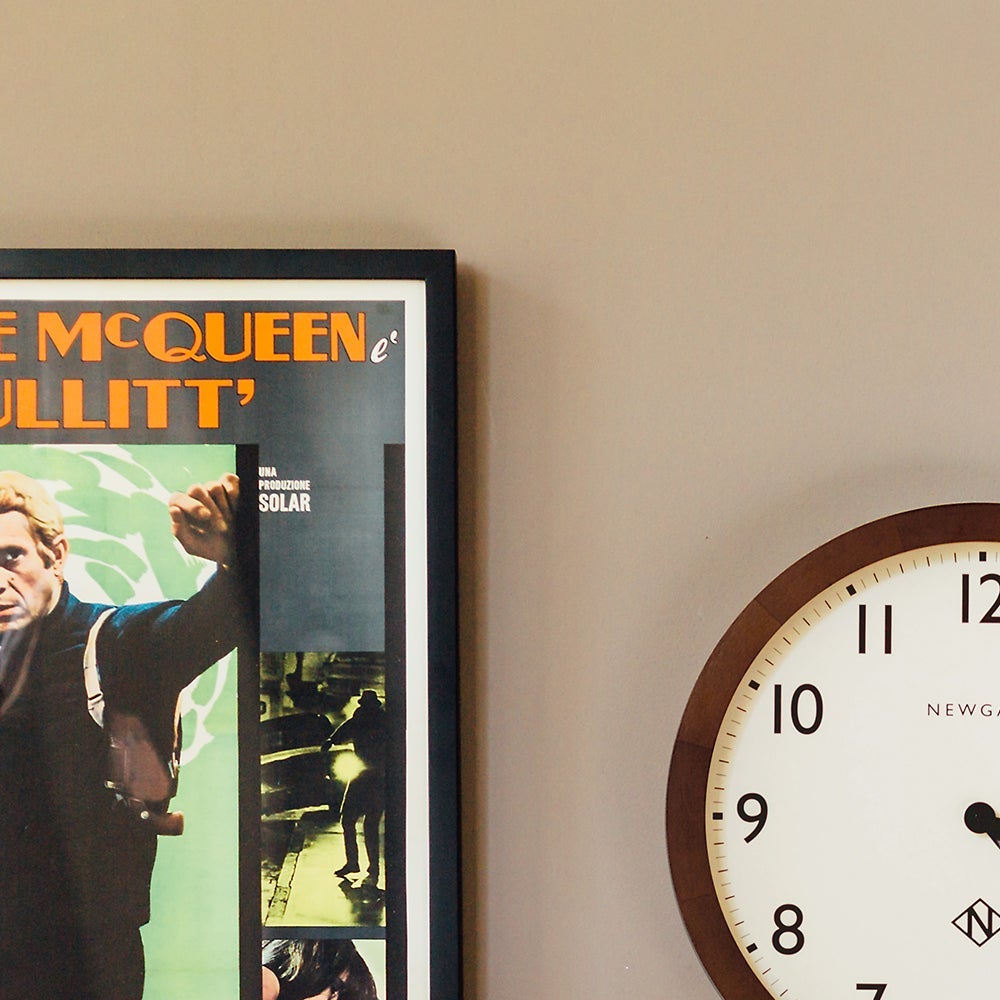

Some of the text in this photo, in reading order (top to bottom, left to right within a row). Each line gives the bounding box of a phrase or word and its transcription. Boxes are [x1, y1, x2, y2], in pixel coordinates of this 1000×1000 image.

[0, 378, 255, 430] LLITT'
[258, 466, 277, 478] UNA
[258, 480, 311, 491] PRODUZIONE
[258, 493, 312, 513] SOLAR
[858, 604, 893, 655] 11
[773, 683, 824, 735] 10
[736, 792, 769, 844] 9
[771, 903, 805, 956] 8
